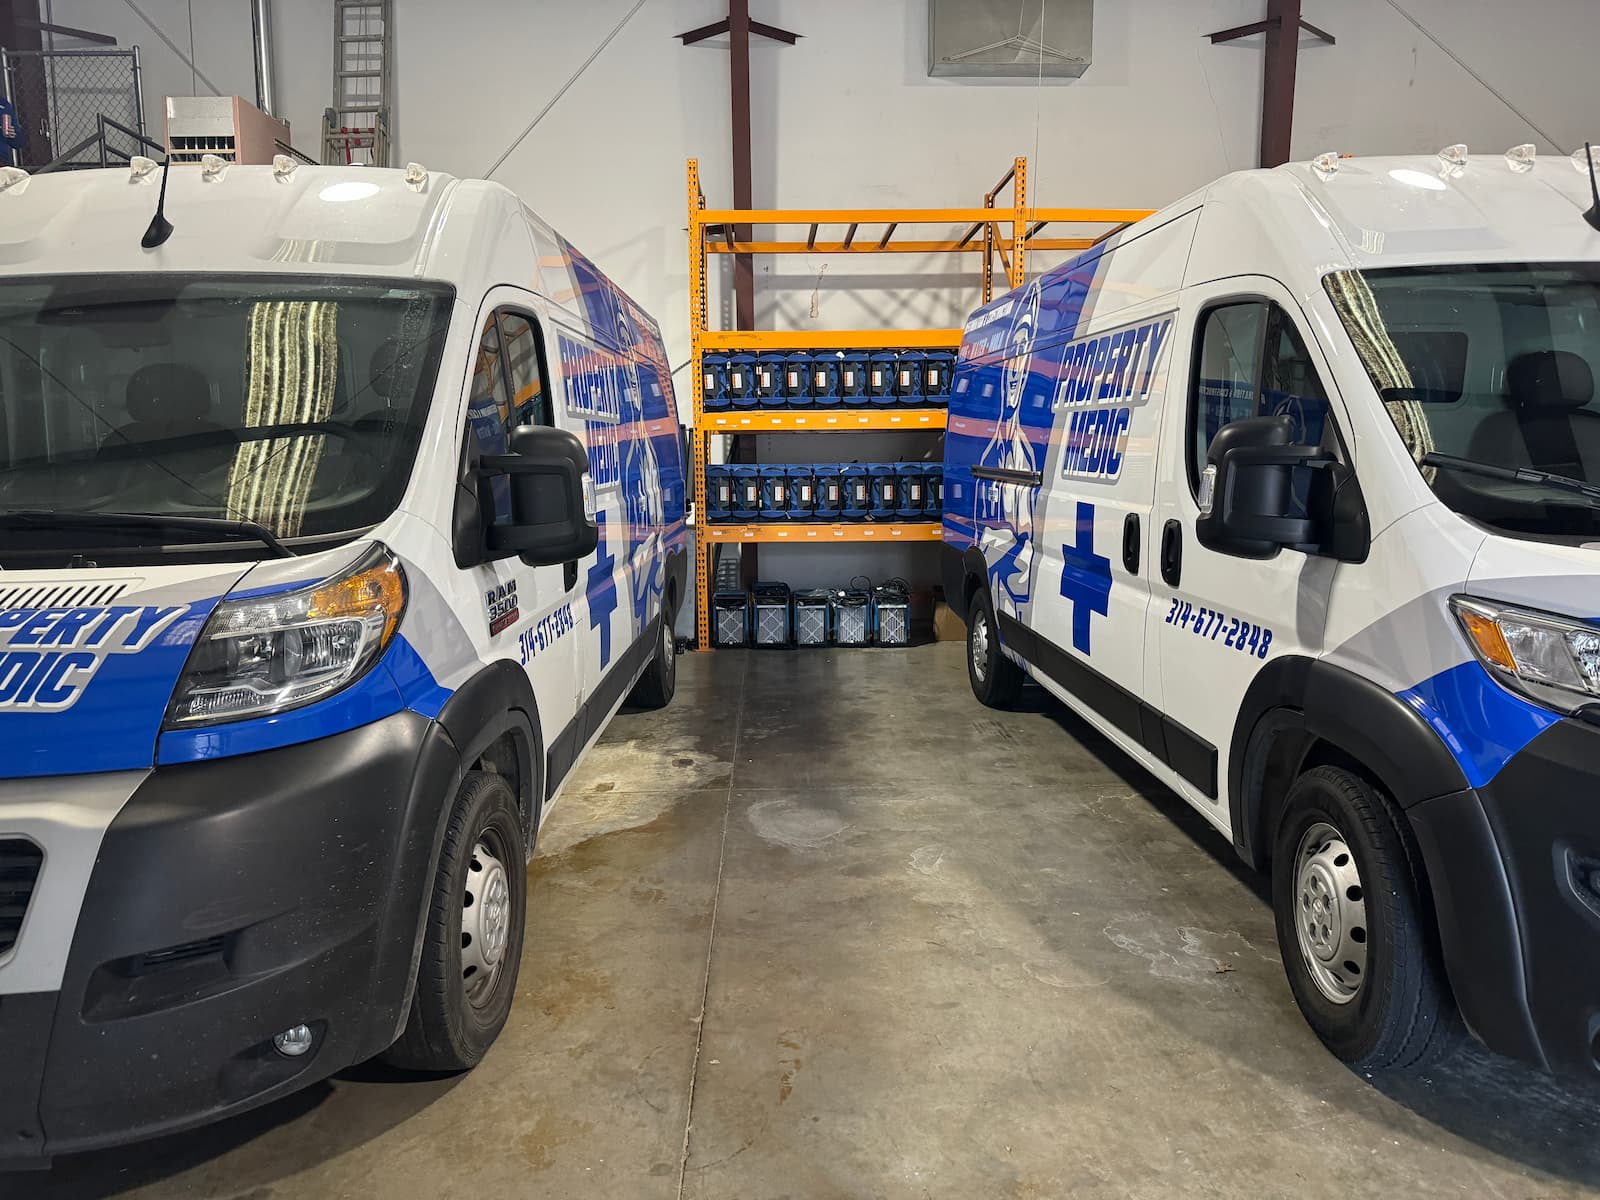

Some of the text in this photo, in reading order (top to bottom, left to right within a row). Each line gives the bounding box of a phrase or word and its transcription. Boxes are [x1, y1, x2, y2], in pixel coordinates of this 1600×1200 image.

[1053, 317, 1173, 409] PROPERTY
[1063, 407, 1130, 481] MEDIC
[485, 578, 517, 606] RAM
[487, 593, 518, 622] 3500
[0, 606, 187, 649] PERTY
[519, 602, 574, 666] 314-677-2848
[1165, 597, 1273, 660] 314-677-2848
[0, 652, 99, 707] DIC
